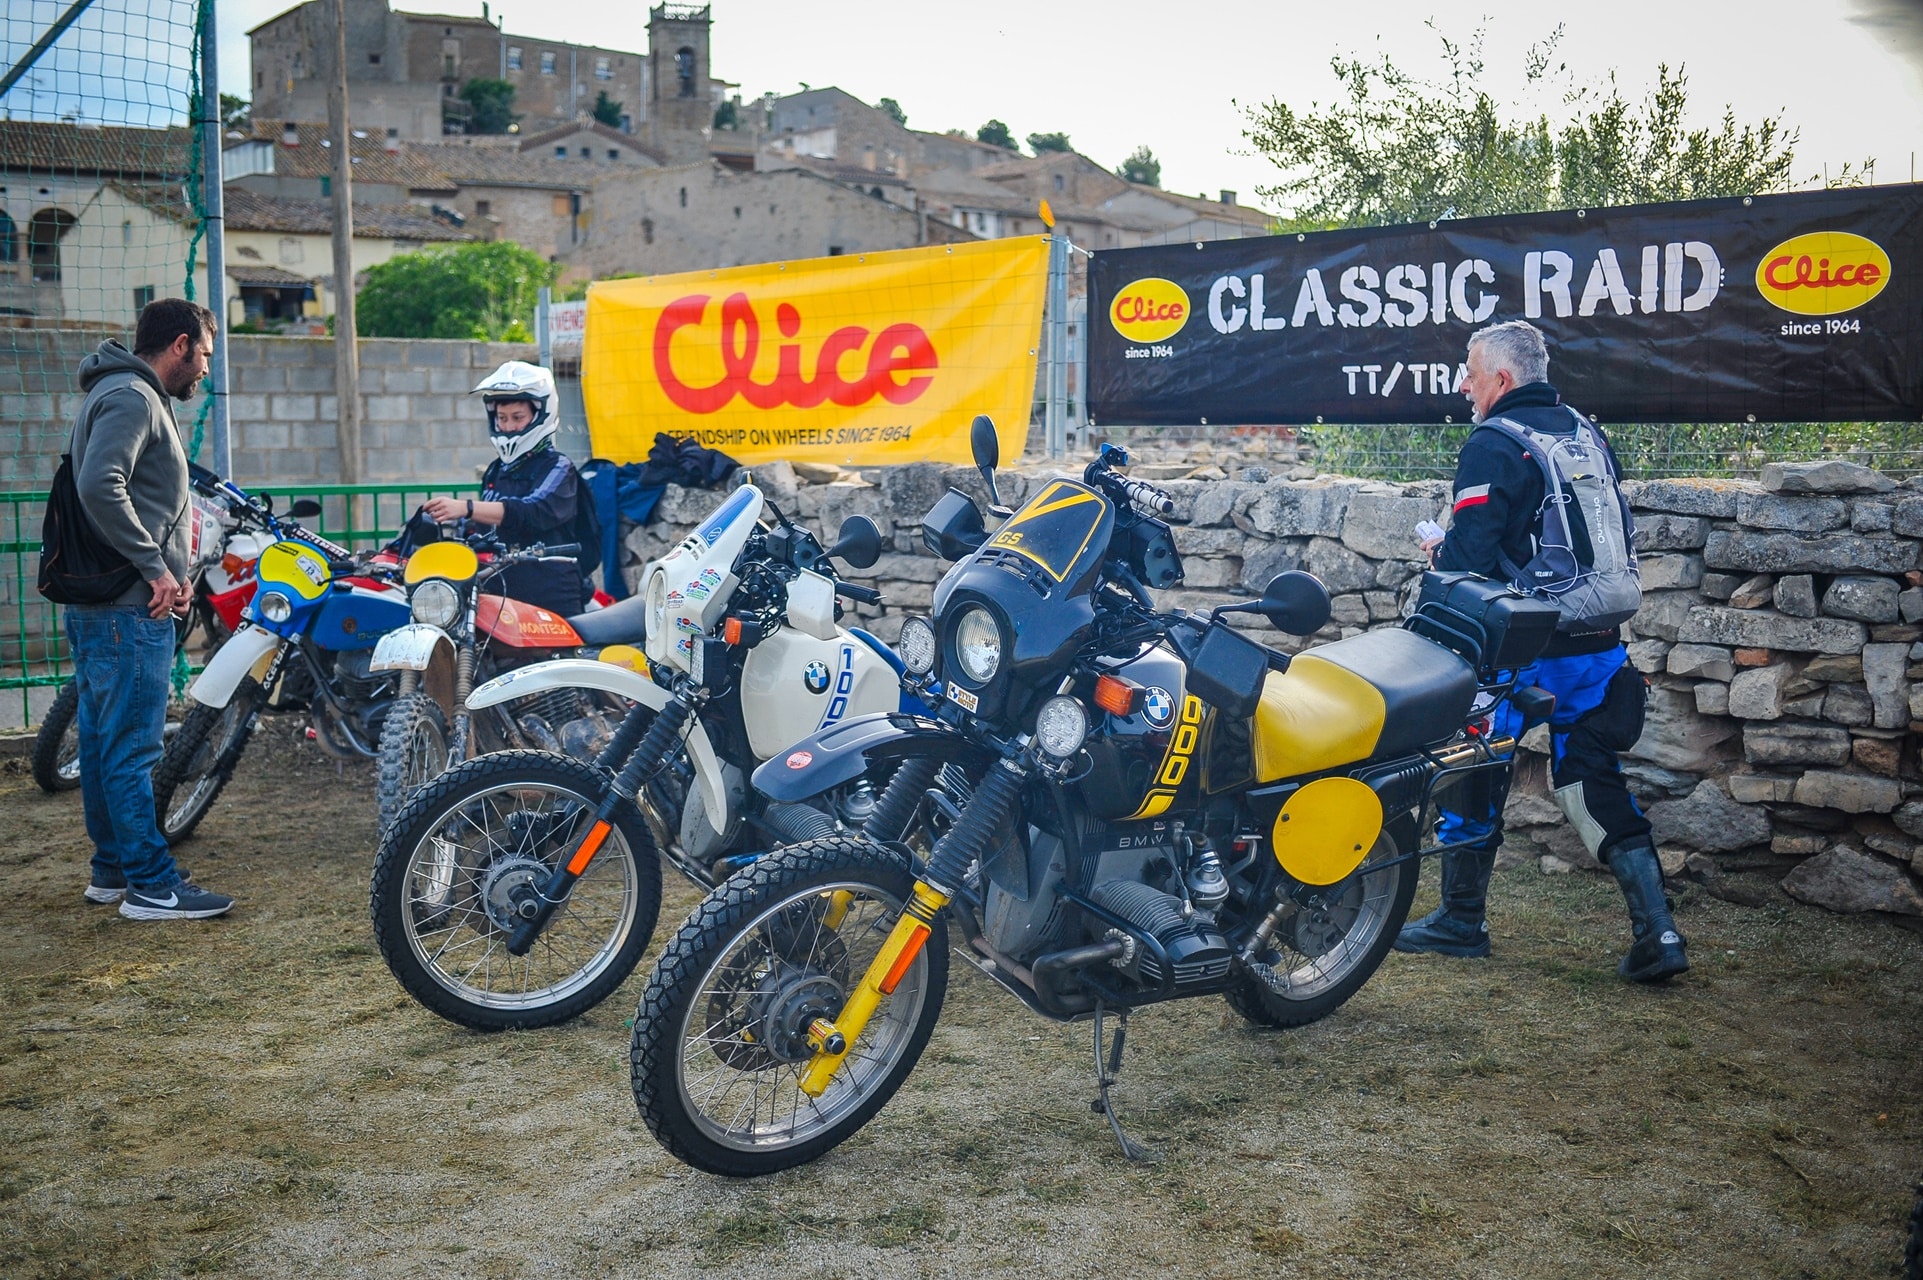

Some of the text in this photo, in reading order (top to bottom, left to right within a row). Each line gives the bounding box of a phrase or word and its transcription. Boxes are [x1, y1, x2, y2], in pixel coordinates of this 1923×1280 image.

[1765, 255, 1881, 291] Clice
[1207, 241, 1722, 334] CLASSIC RAID
[1116, 296, 1184, 324] Clice
[1781, 319, 1861, 335] since 1964
[653, 291, 939, 414] Clice
[1125, 345, 1173, 358] since 1964
[749, 429, 771, 445] ON
[772, 428, 834, 445] WHEELS
[835, 427, 878, 445] SINCE
[878, 425, 912, 442] 1964
[1593, 496, 1606, 544] Quechua
[996, 531, 1024, 546] GS
[519, 621, 572, 635] MONTESA
[1119, 833, 1164, 848] BMW
